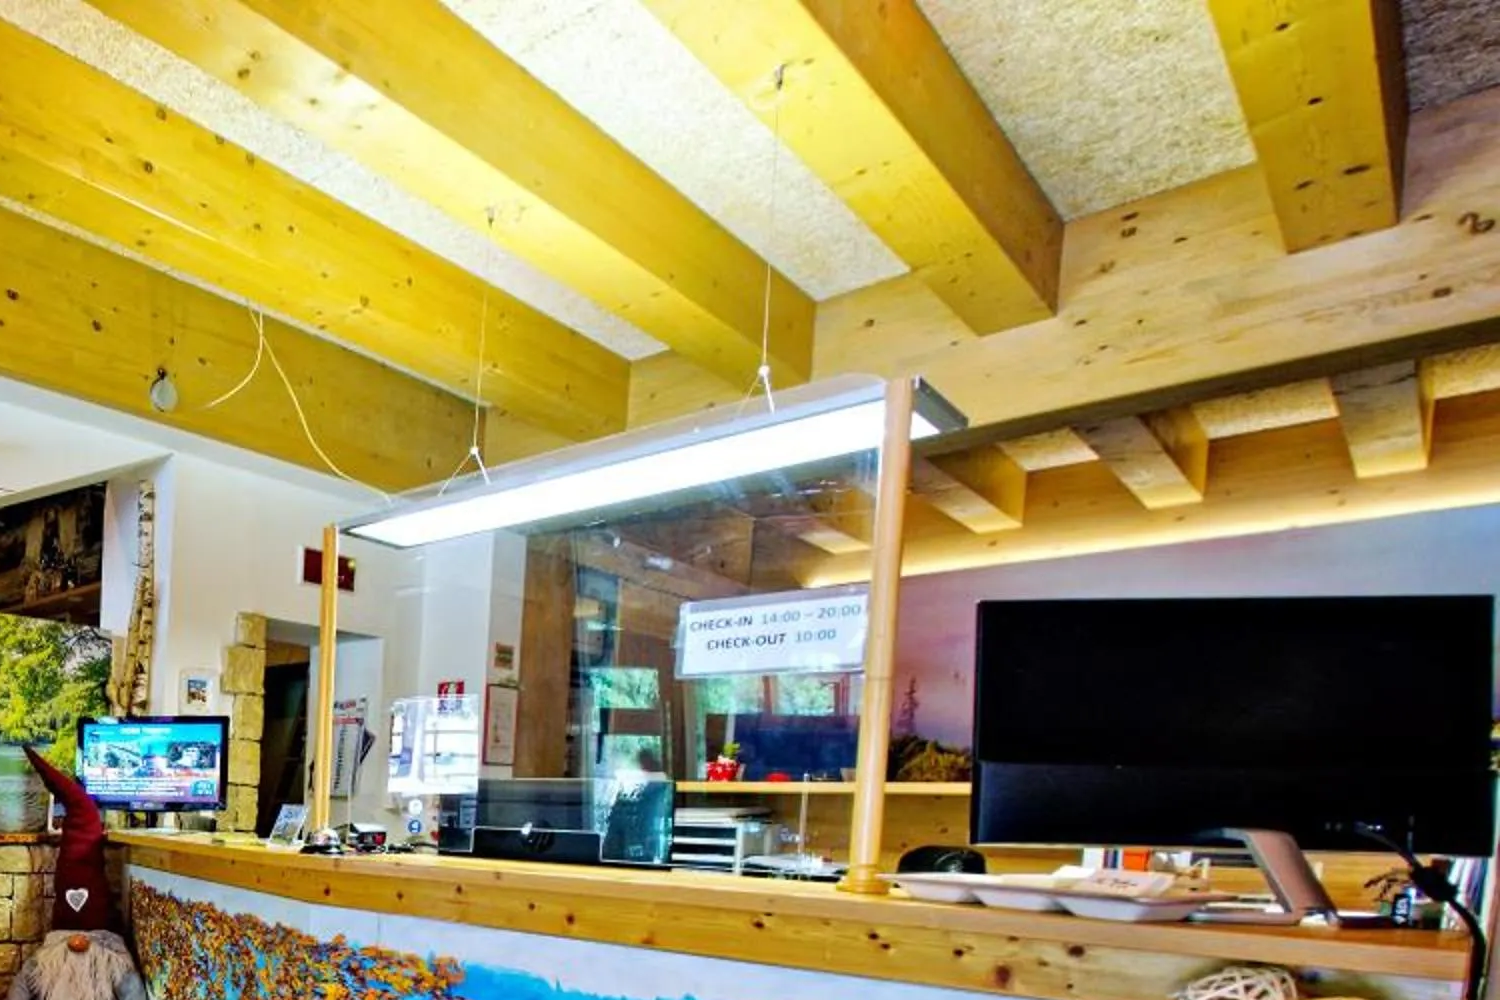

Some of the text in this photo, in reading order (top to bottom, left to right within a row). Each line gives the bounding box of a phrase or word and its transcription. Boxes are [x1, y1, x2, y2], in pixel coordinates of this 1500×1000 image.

[689, 614, 753, 633] CHECK-IN
[760, 609, 801, 626] 14:00
[816, 603, 862, 620] 20:00
[706, 628, 837, 651] CHECK-OUT 10:00
